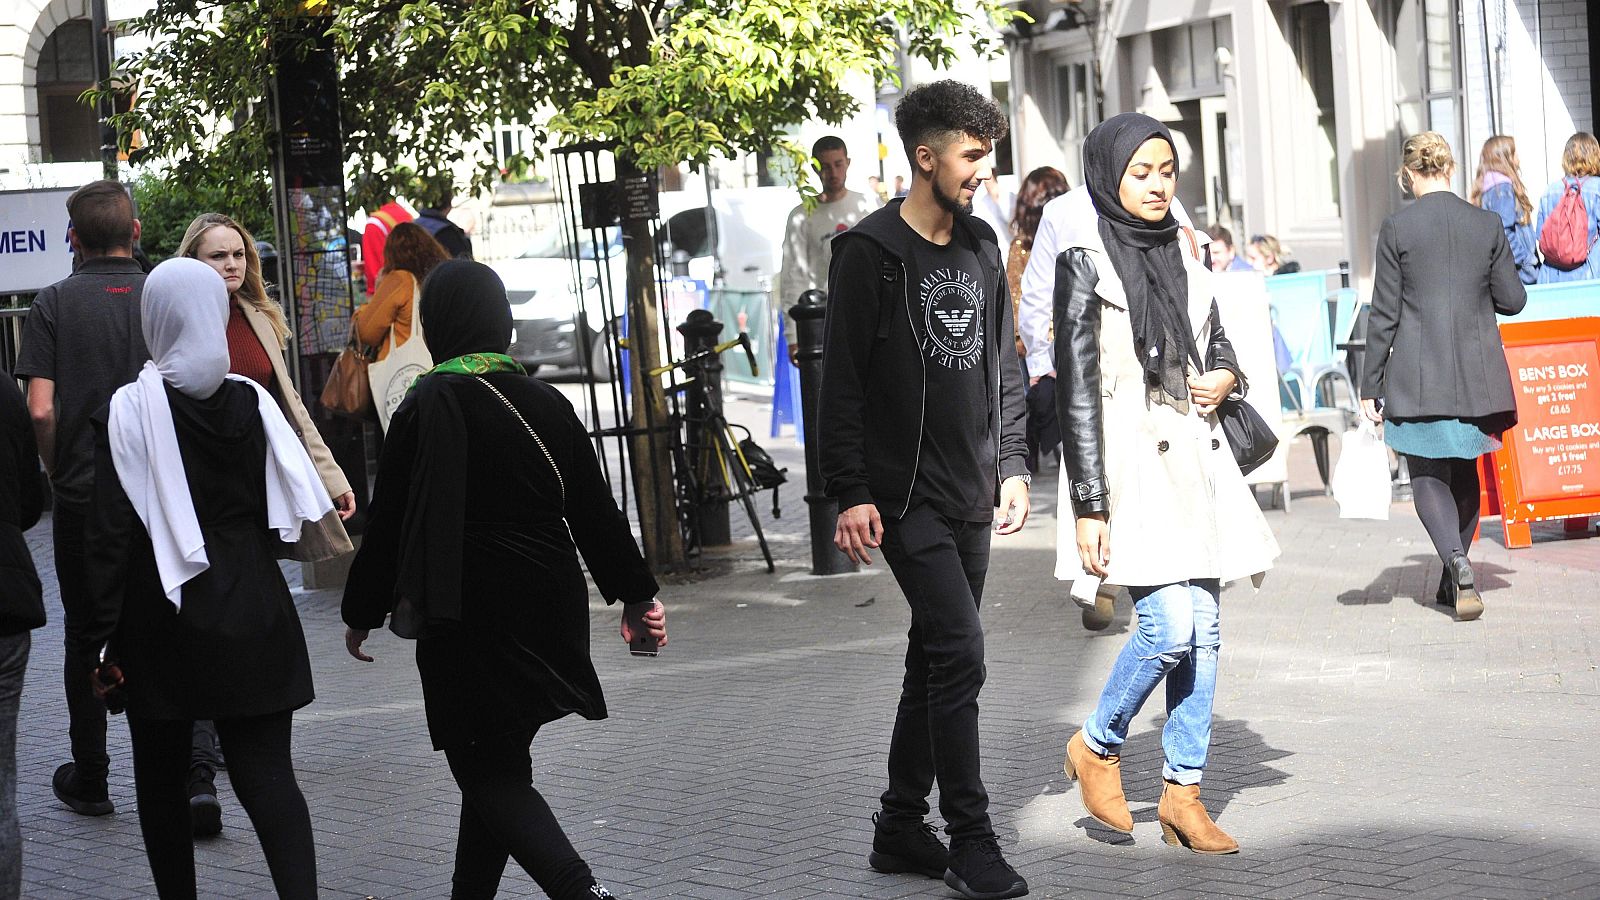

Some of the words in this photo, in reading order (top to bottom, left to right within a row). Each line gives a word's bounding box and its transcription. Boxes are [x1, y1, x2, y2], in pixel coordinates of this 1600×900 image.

[932, 289, 947, 307] MADE
[1518, 365, 1556, 381] BEN'S
[1558, 363, 1588, 378] BOX
[1553, 382, 1575, 392] cookies
[1576, 381, 1587, 390] and
[1537, 393, 1550, 405] get
[1524, 425, 1568, 442] LARGE
[1571, 422, 1600, 438] BOX
[1566, 442, 1588, 452] cookies
[1548, 454, 1561, 465] get
[1558, 464, 1582, 476] £17.75
